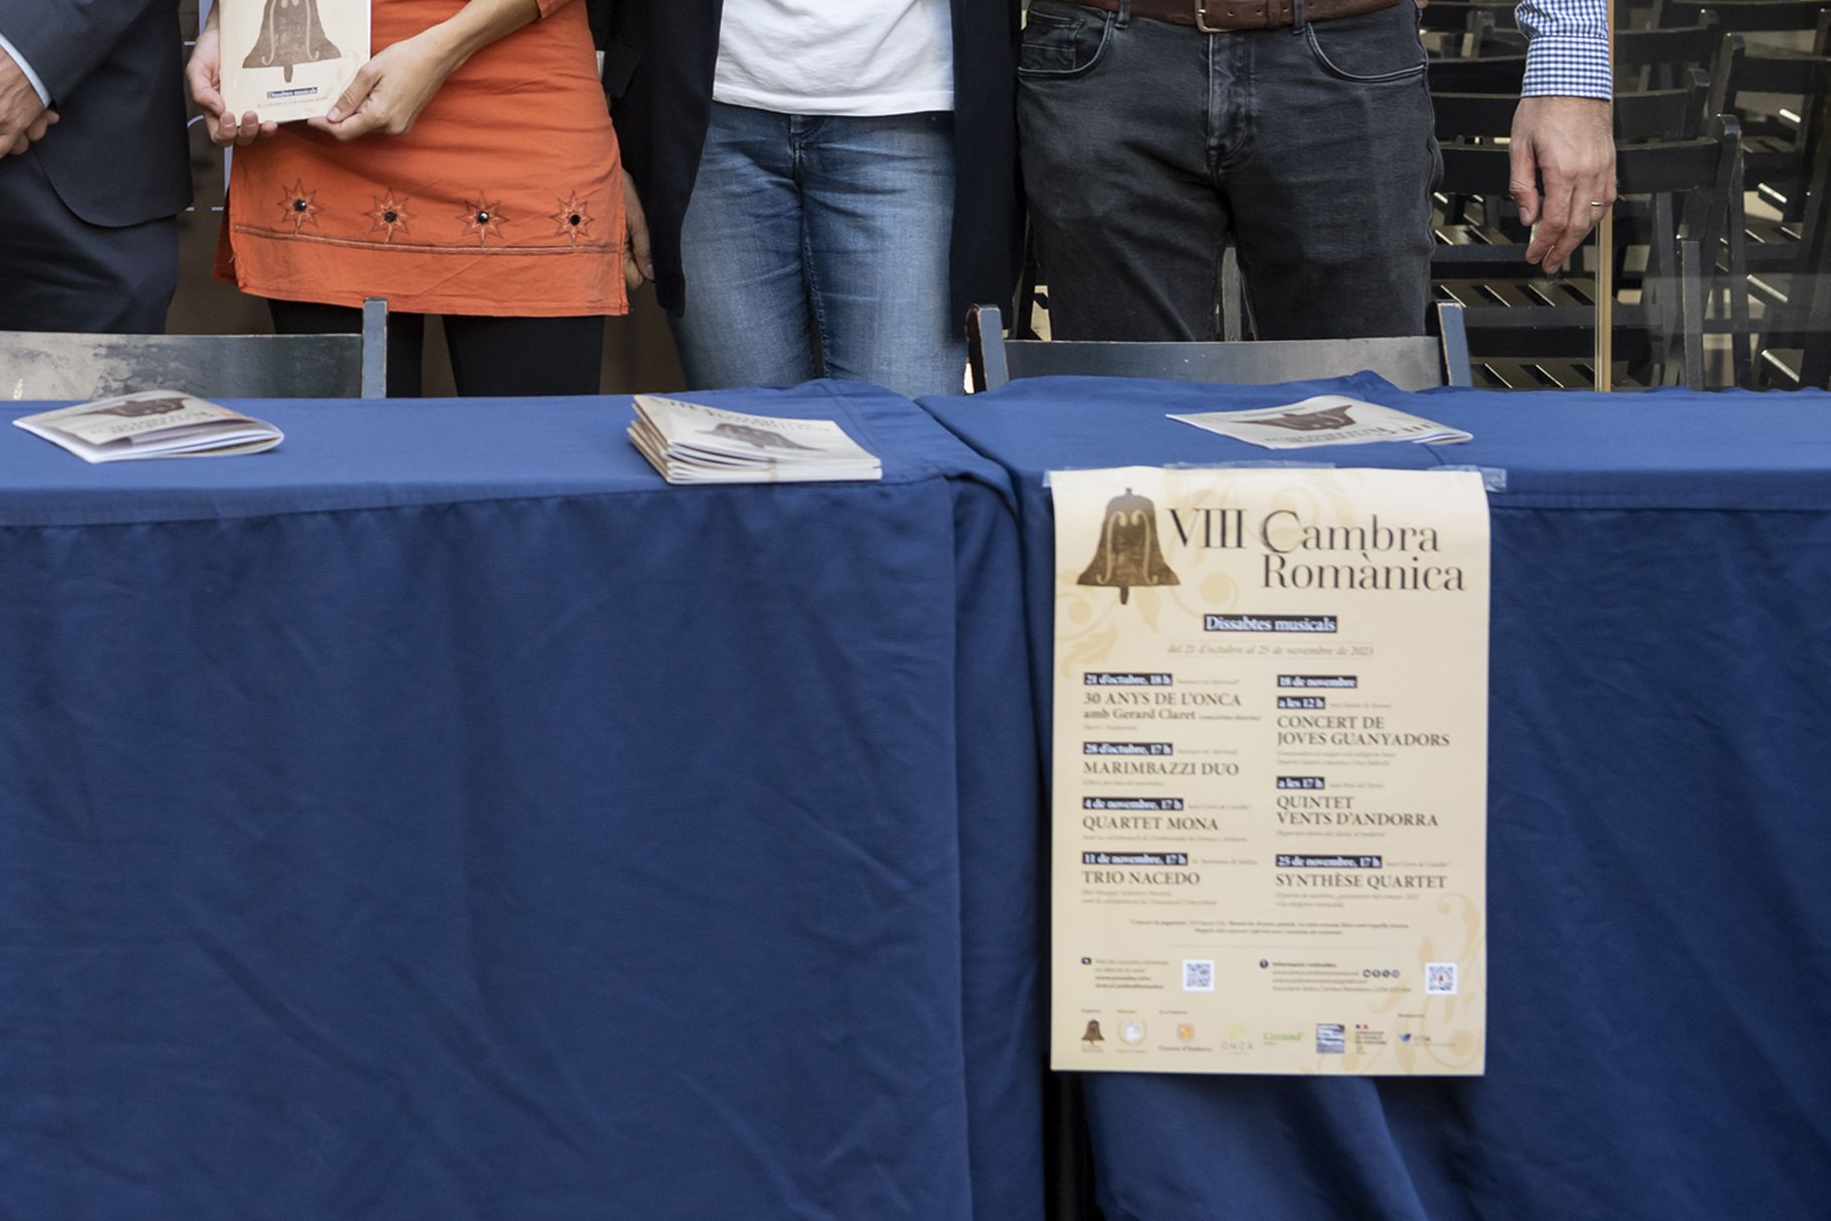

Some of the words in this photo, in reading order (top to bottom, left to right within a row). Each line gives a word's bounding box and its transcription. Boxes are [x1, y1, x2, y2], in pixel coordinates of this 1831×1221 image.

[1166, 508, 1248, 549] VIII
[1259, 510, 1440, 553] Cambra
[1260, 551, 1466, 590] Romànica
[1205, 616, 1270, 632] Dissabtes
[1274, 617, 1336, 632] musicals
[1084, 692, 1101, 704] 30
[1106, 692, 1149, 705] ANYS
[1155, 693, 1177, 706] DE
[1181, 692, 1241, 706] L'ONCA
[1084, 709, 1109, 719] amb
[1113, 709, 1155, 719] Gerard
[1159, 709, 1196, 719] Claret
[1277, 716, 1358, 729] CONCERT
[1363, 716, 1384, 729] DE
[1277, 732, 1327, 746] JOVES
[1331, 732, 1450, 746] GUANYADORS
[1083, 762, 1196, 775] MARIMBAZZI
[1202, 763, 1239, 775] DUO
[1277, 796, 1354, 810] QUINTET
[1083, 816, 1163, 830] QUARTET
[1167, 817, 1218, 830] MONA
[1277, 812, 1331, 825] VENTS
[1337, 812, 1438, 826] D'ANDORRA
[1082, 871, 1124, 884] TRIO
[1129, 872, 1200, 884] NACEDO
[1276, 873, 1363, 888] SYNTHÈSE
[1367, 875, 1446, 890] QUARTET
